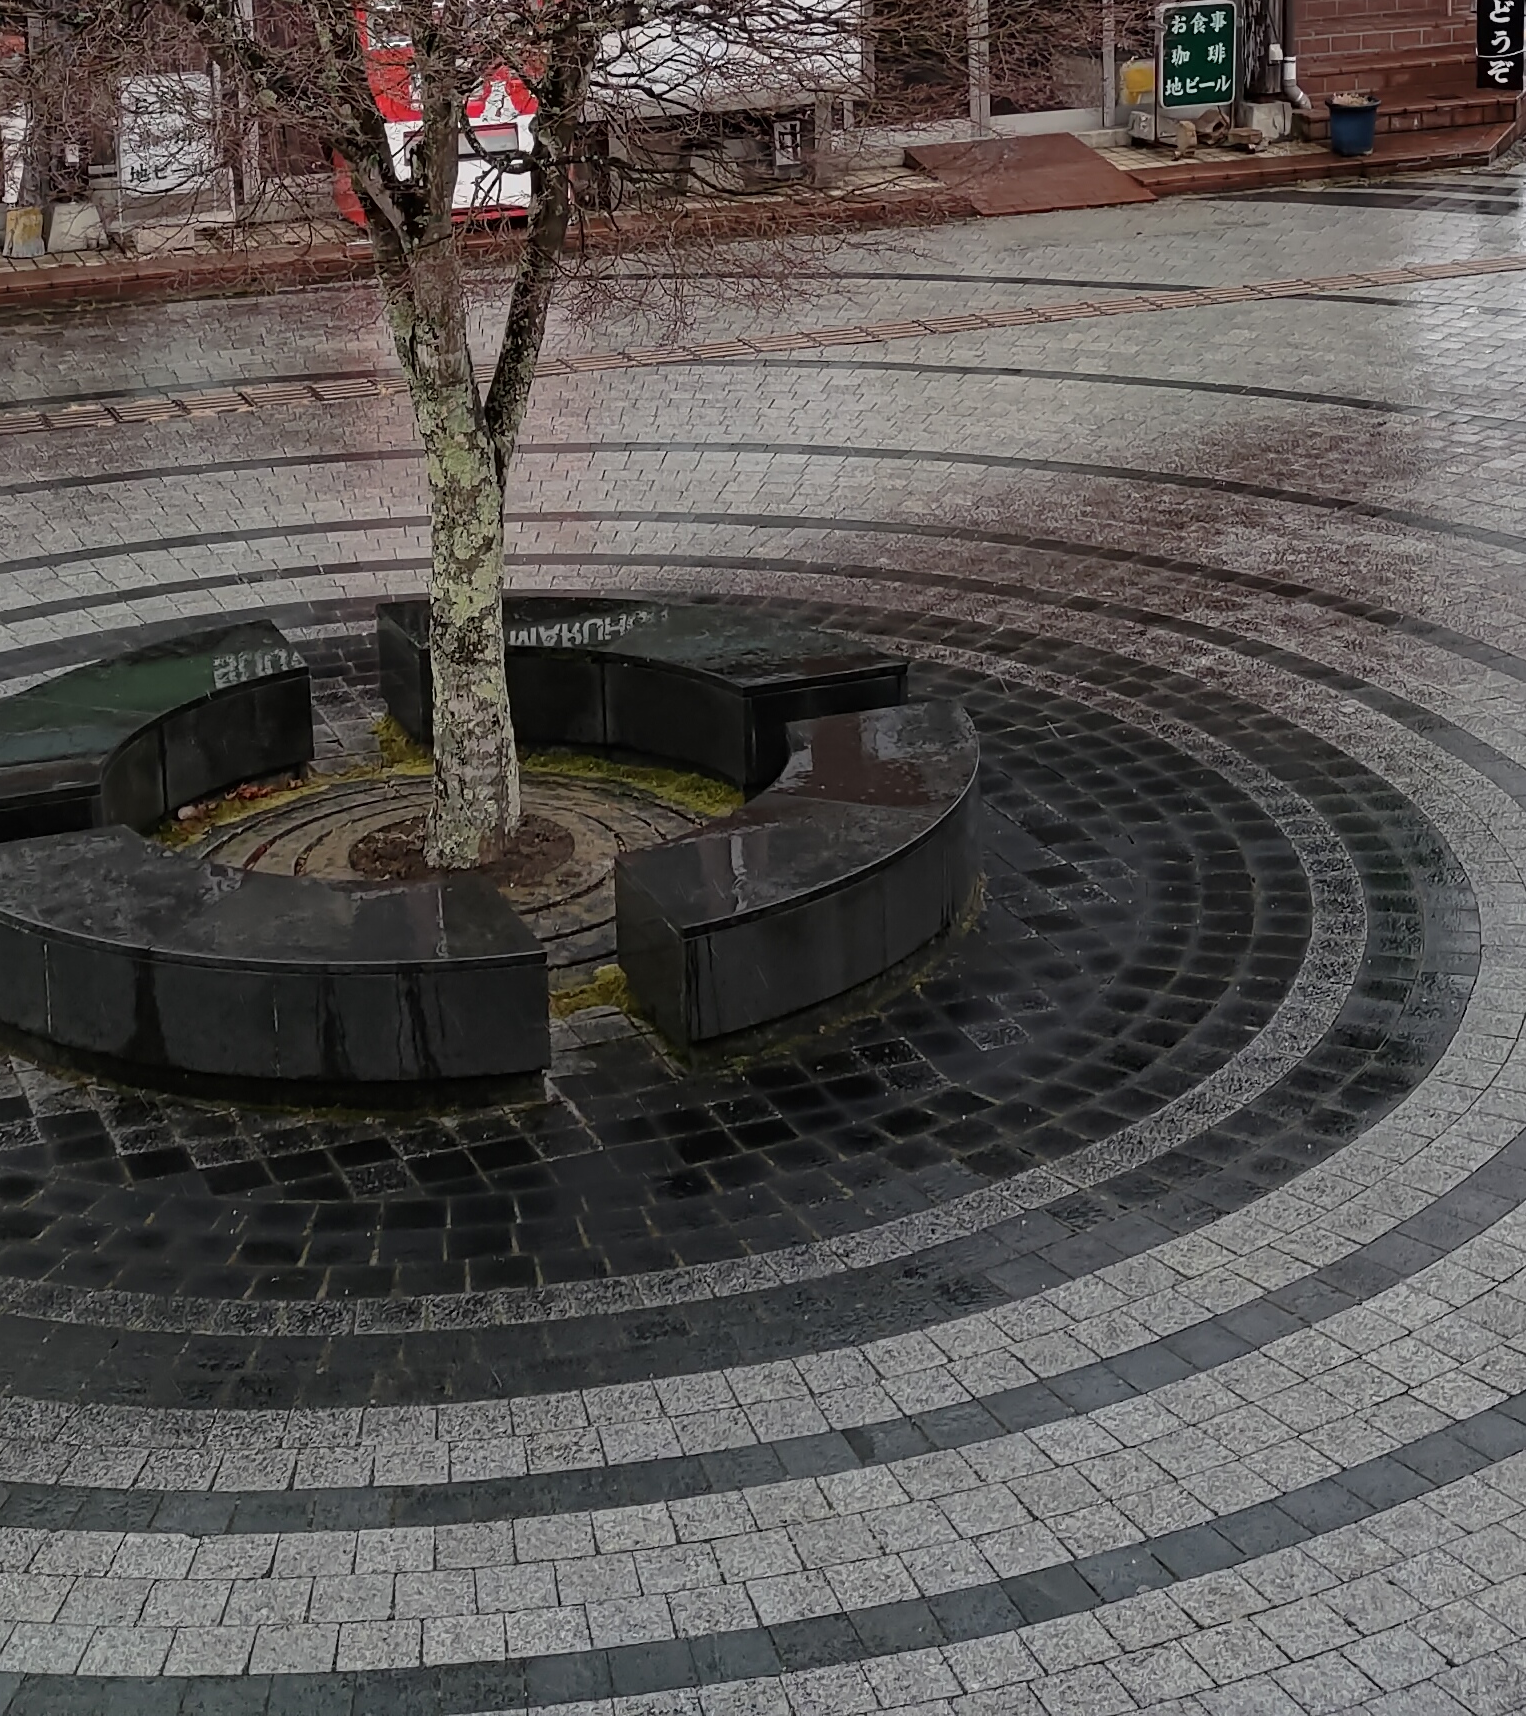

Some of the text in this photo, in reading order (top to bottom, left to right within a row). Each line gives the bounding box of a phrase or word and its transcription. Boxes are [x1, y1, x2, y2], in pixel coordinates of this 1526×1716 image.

[1171, 10, 1228, 35] お食事
[1170, 42, 1227, 67] 珈琲
[1164, 74, 1232, 97] 地ビール
